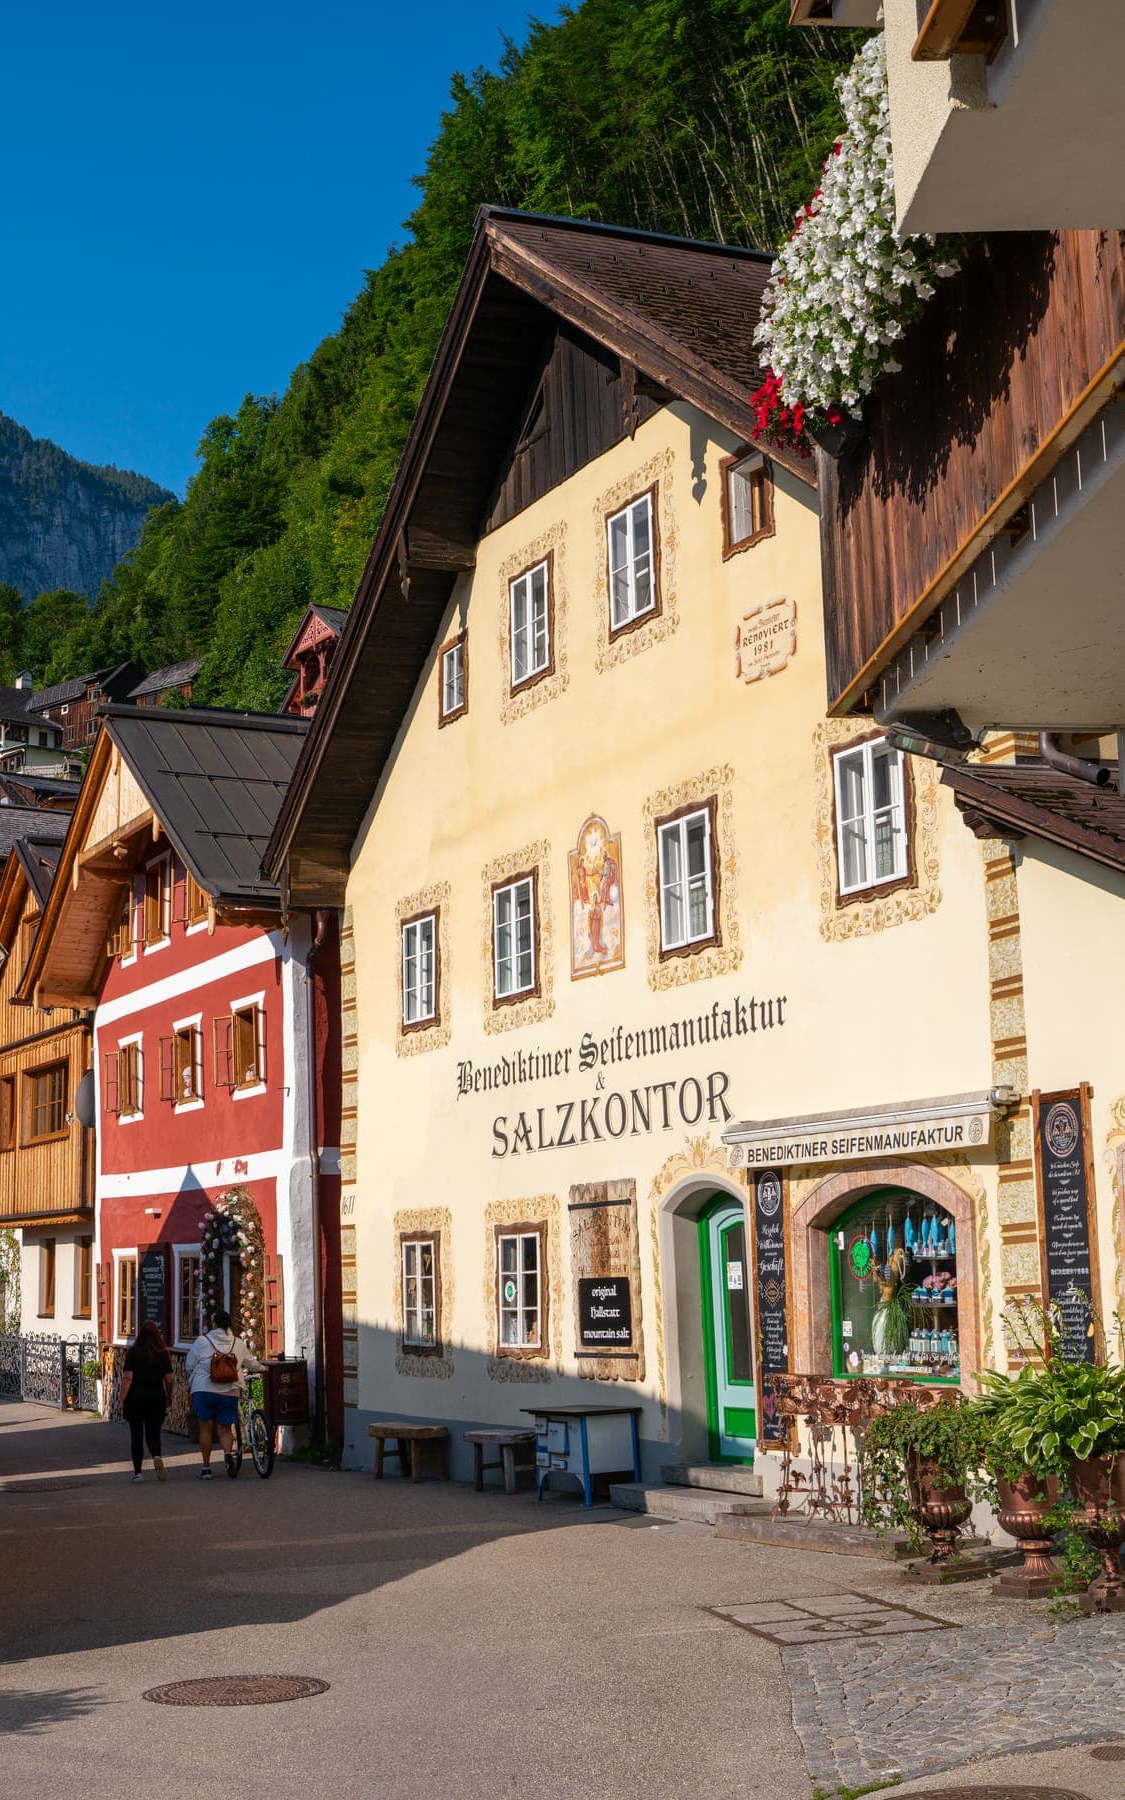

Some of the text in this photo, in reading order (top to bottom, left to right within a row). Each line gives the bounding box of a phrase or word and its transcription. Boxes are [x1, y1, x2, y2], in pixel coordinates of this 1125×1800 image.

[742, 618, 790, 647] RENOVIERT
[754, 640, 773, 656] 1981
[456, 995, 788, 1100] Benediktiner Seifenmanufaktur
[595, 1071, 606, 1091] &
[491, 1071, 733, 1158] SALZKONTOR
[747, 1125, 964, 1164] BENEDIKTINER SEIFENMANUFAKTUR
[591, 1284, 617, 1301] original
[583, 1326, 630, 1339] mountain salt
